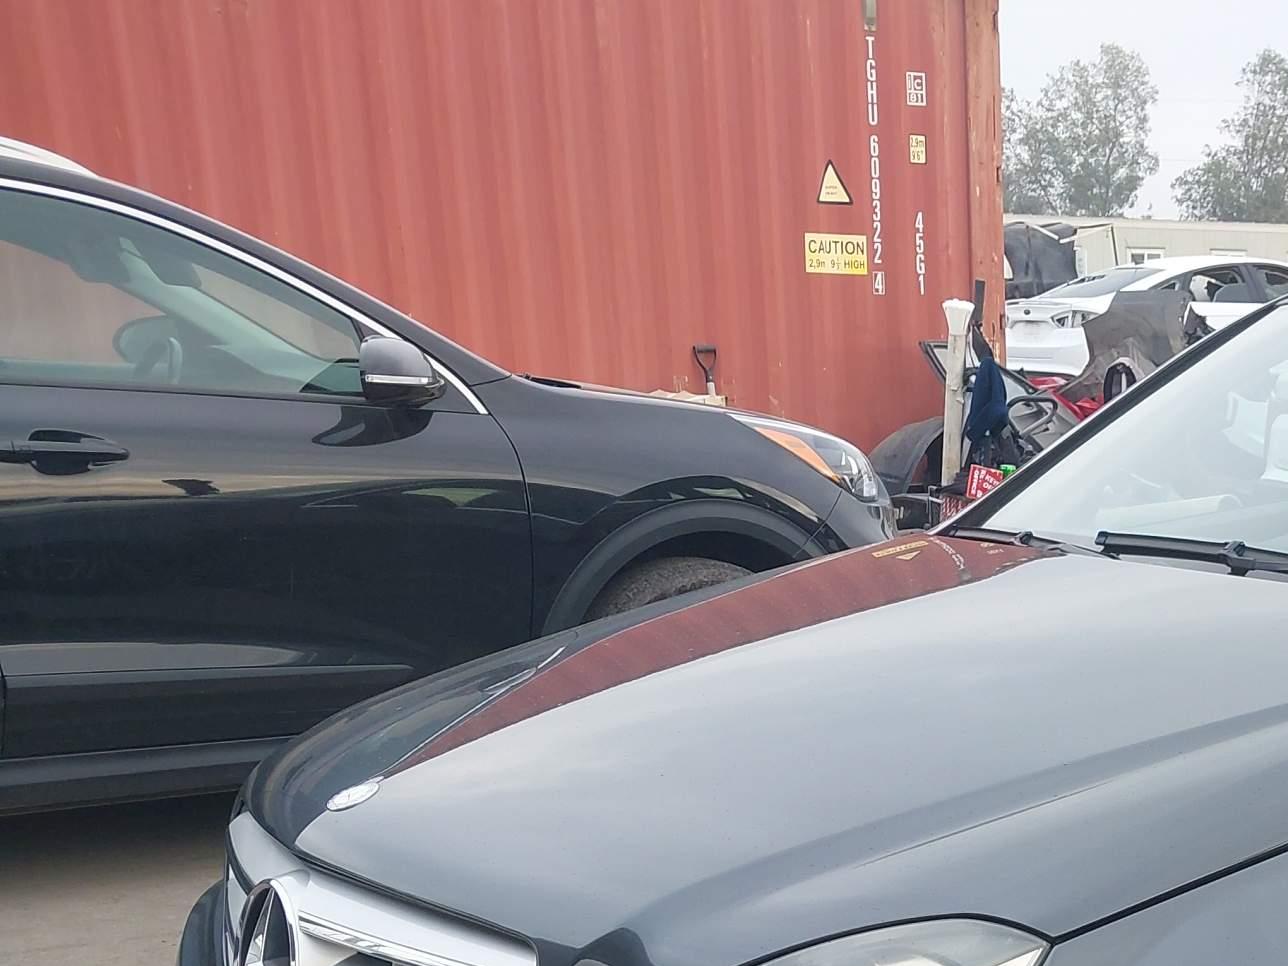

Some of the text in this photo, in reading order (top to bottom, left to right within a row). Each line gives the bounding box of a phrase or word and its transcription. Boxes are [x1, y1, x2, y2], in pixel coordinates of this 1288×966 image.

[864, 35, 884, 295] TGHU 609322 4
[808, 239, 865, 256] CAUTION
[843, 259, 865, 270] HIGH
[915, 211, 926, 296] 45G1
